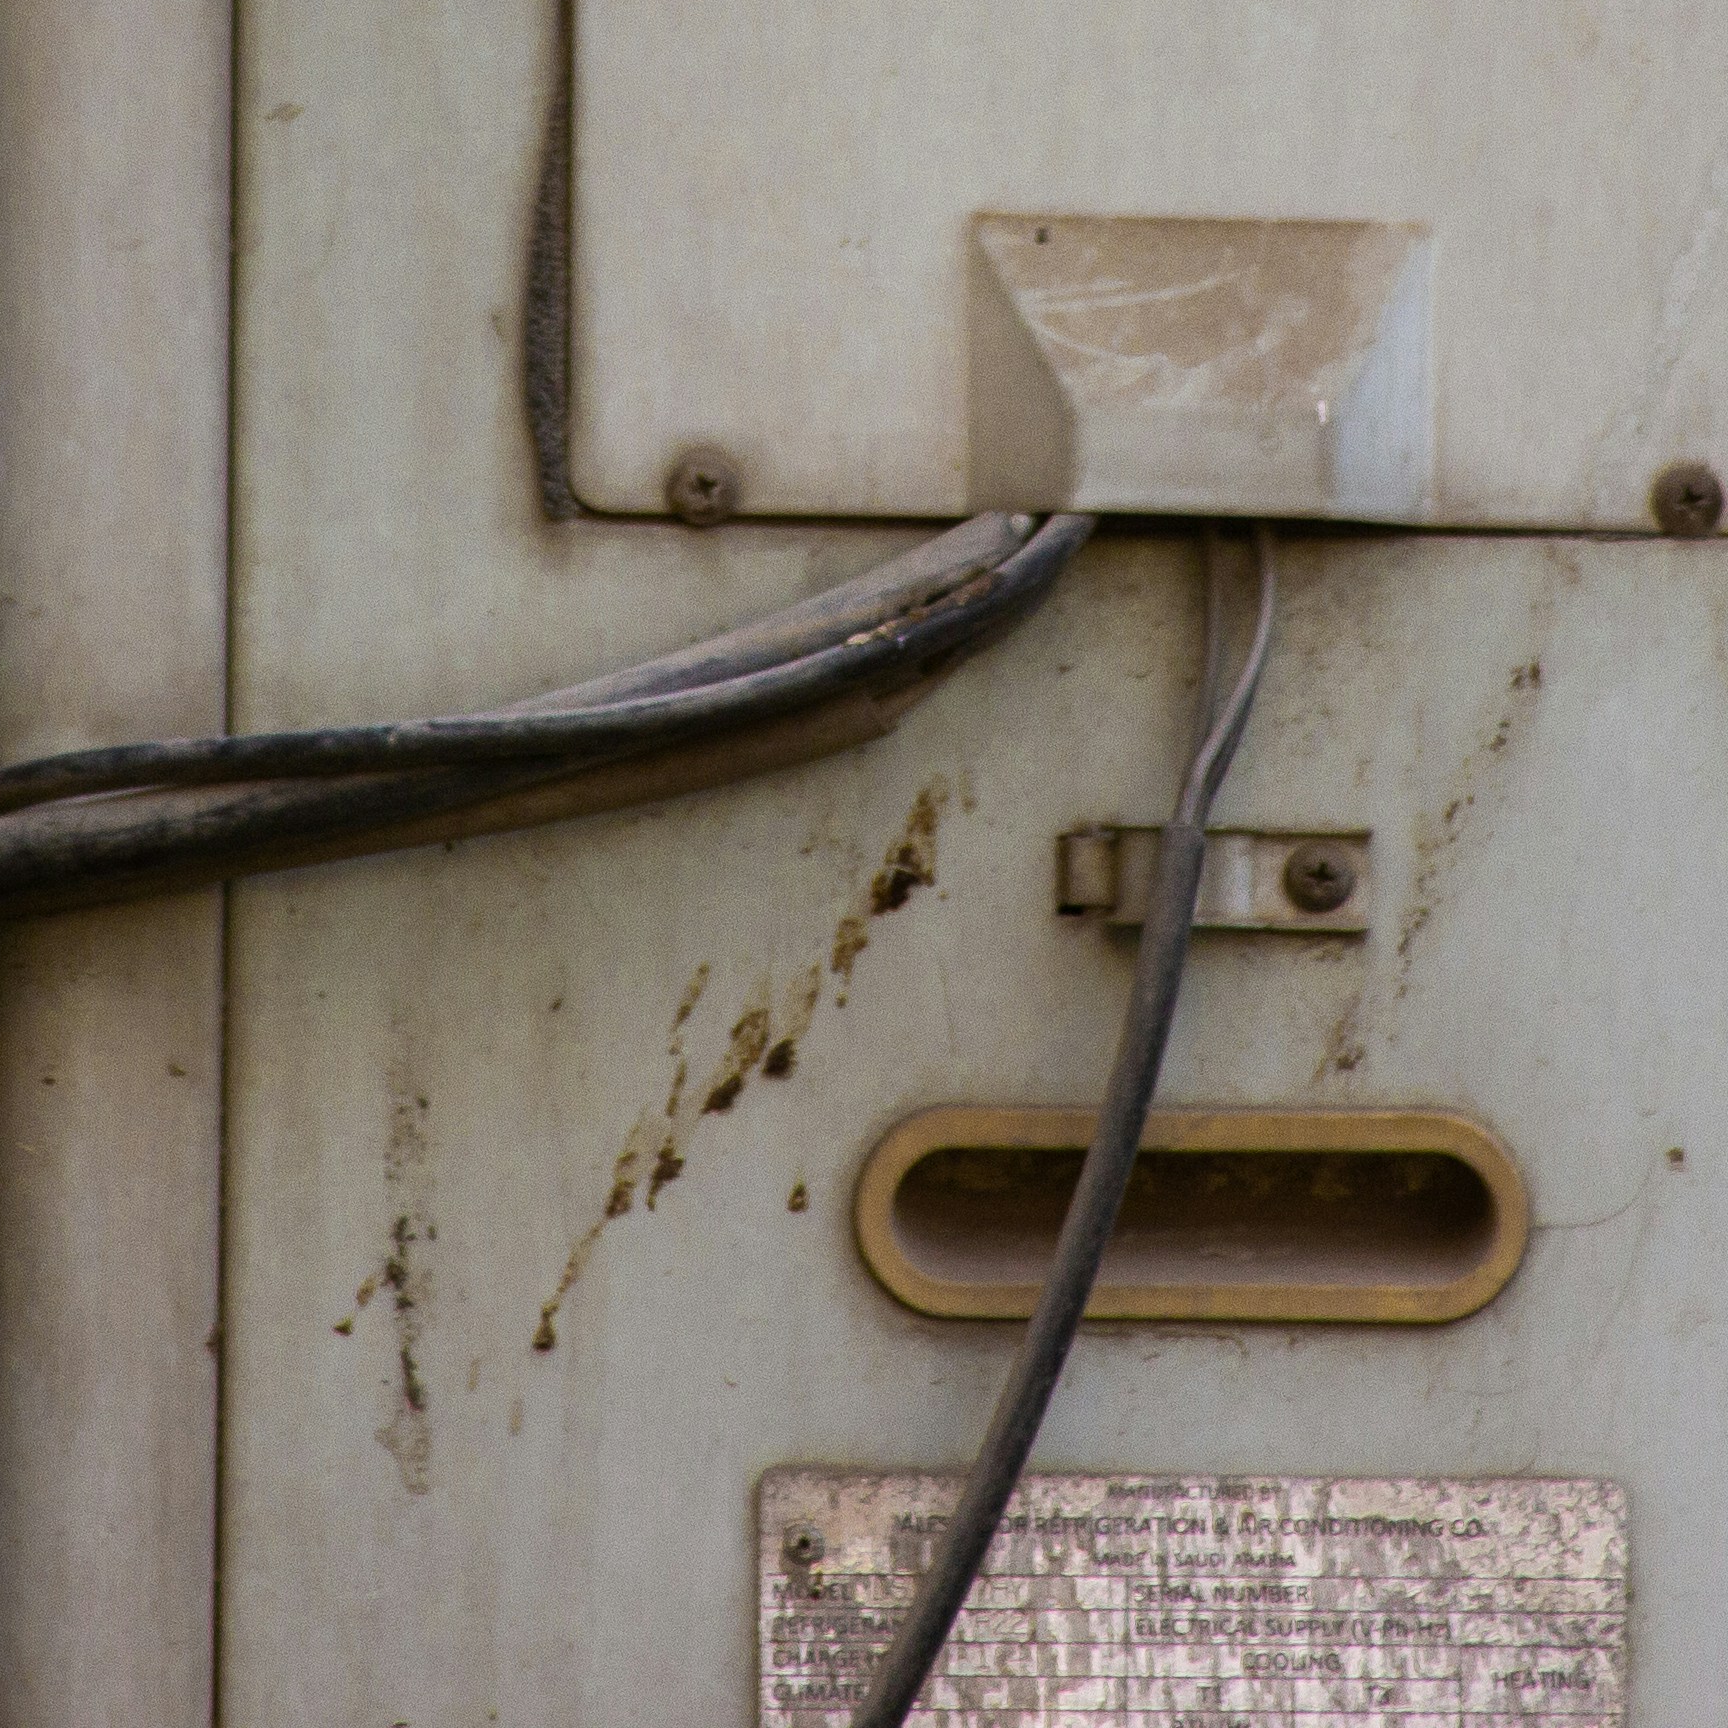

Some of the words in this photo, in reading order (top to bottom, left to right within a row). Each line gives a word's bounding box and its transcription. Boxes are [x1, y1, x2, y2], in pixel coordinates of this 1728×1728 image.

[999, 1514, 1030, 1535] OR
[1035, 1515, 1206, 1536] REFRIGERATION
[1213, 1515, 1230, 1537] &
[1238, 1515, 1275, 1537] AIR
[1281, 1516, 1444, 1538] CONDITIONING
[1093, 1551, 1148, 1567] MADE
[1173, 1552, 1224, 1568] SAUDI
[1234, 1551, 1296, 1568] ARABIA
[773, 1582, 852, 1602] MODEL
[1133, 1583, 1206, 1604] SERIAL
[1213, 1583, 1310, 1604] NUMBER
[1135, 1618, 1258, 1639] ELECTRICAL
[1265, 1618, 1345, 1639] SUPPLY
[1243, 1651, 1343, 1672] COOLING
[1492, 1668, 1592, 1690] HEATING
[773, 1681, 865, 1702] CLIMATE
